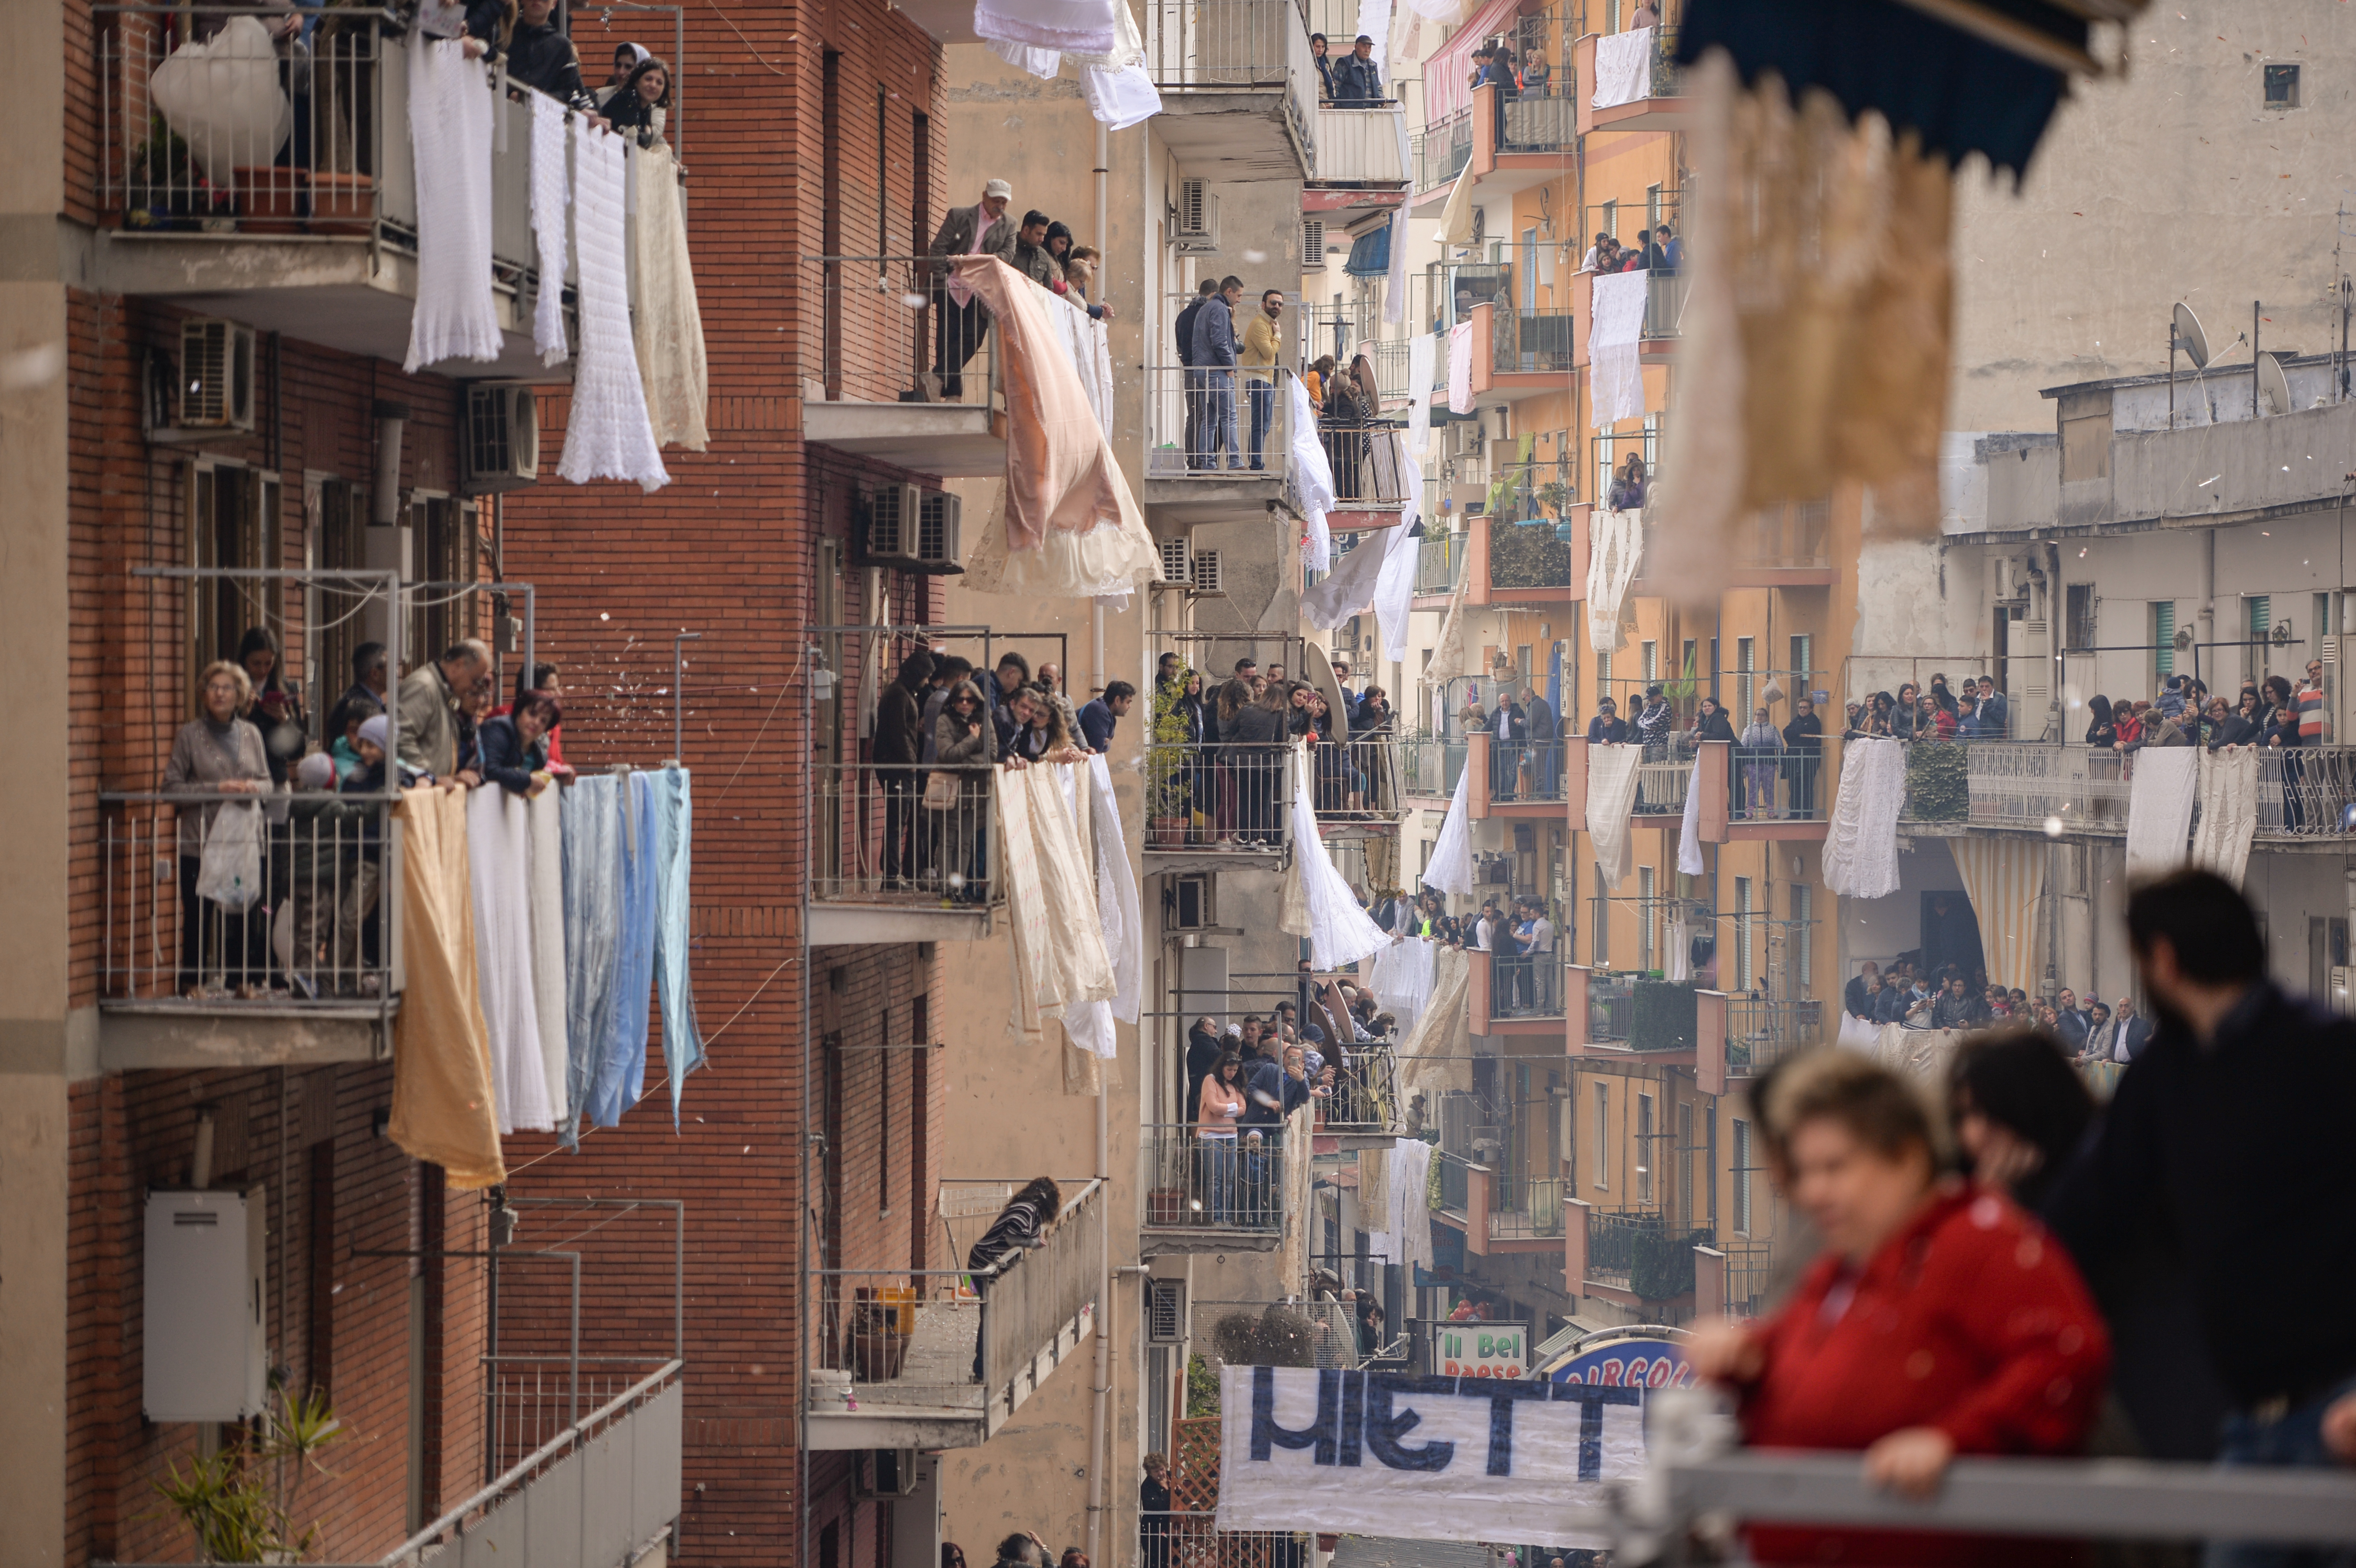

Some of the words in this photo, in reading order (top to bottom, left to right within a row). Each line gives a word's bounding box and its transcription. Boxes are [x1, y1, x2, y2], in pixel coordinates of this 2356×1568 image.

[1431, 1237, 1454, 1246] ulito
[1478, 1333, 1519, 1358] Bel
[1445, 1360, 1521, 1380] Paese
[1566, 1358, 1697, 1390] IRCOL
